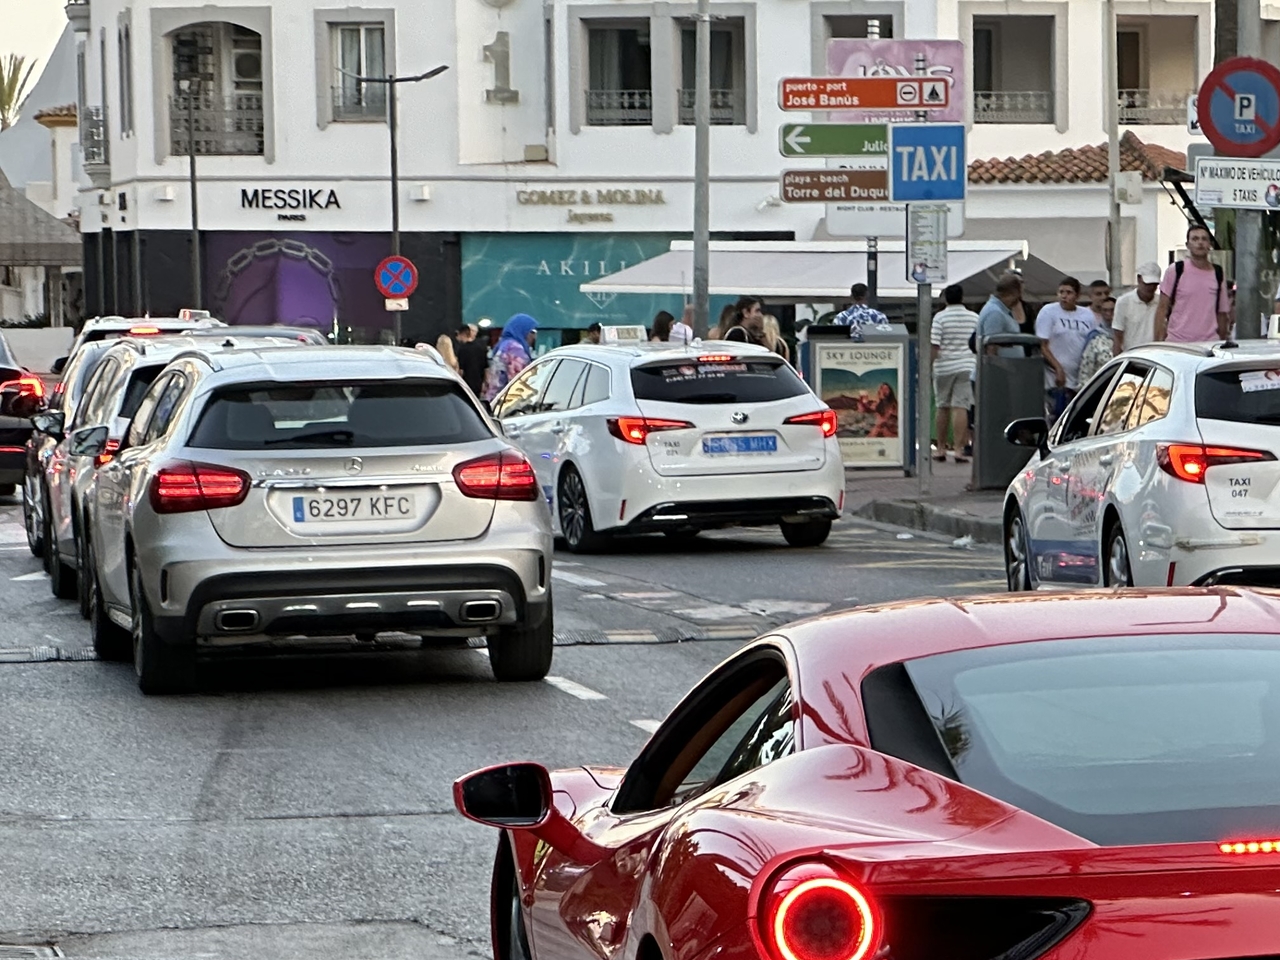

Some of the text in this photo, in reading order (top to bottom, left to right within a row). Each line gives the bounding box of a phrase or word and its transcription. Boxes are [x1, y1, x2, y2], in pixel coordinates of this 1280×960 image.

[786, 82, 817, 93] puerto
[826, 82, 847, 93] port
[786, 94, 860, 106] José Banús
[1239, 96, 1252, 118] P
[1235, 123, 1256, 134] TAXI
[895, 145, 957, 182] TAXI
[1209, 163, 1236, 180] MÁXIMO
[1237, 167, 1247, 180] DE
[785, 174, 811, 184] playa
[819, 174, 849, 184] beach
[517, 190, 666, 205] GOMEZ & MOLINA
[785, 186, 820, 198] Torre
[825, 186, 846, 198] del
[1233, 189, 1237, 201] 5
[1238, 189, 1258, 202] TAXIS
[241, 189, 341, 209] MESSIKA
[826, 351, 893, 361] SKY LOUNGE
[1229, 478, 1251, 487] TAXI
[1231, 490, 1249, 498] 047
[308, 497, 411, 518] 6297 KFC
